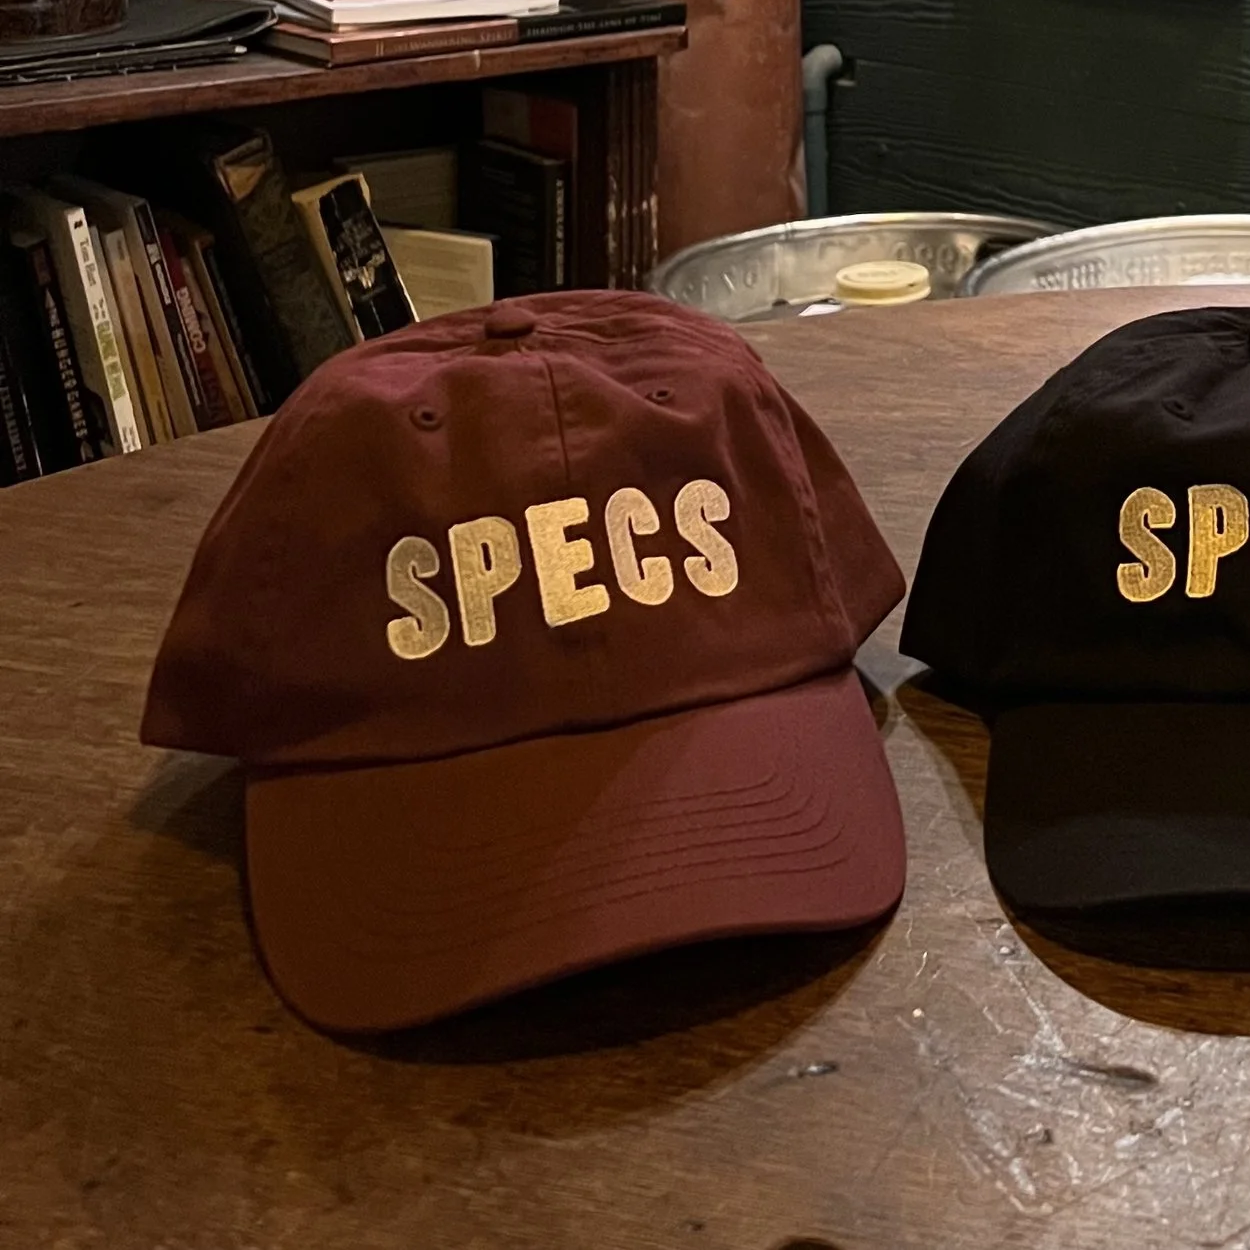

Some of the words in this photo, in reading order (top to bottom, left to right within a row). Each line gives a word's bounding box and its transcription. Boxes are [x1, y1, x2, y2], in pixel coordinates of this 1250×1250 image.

[176, 286, 206, 354] COMING
[52, 327, 77, 390] HUNGER
[67, 390, 88, 439] GAMES
[386, 479, 739, 659] SPECS
